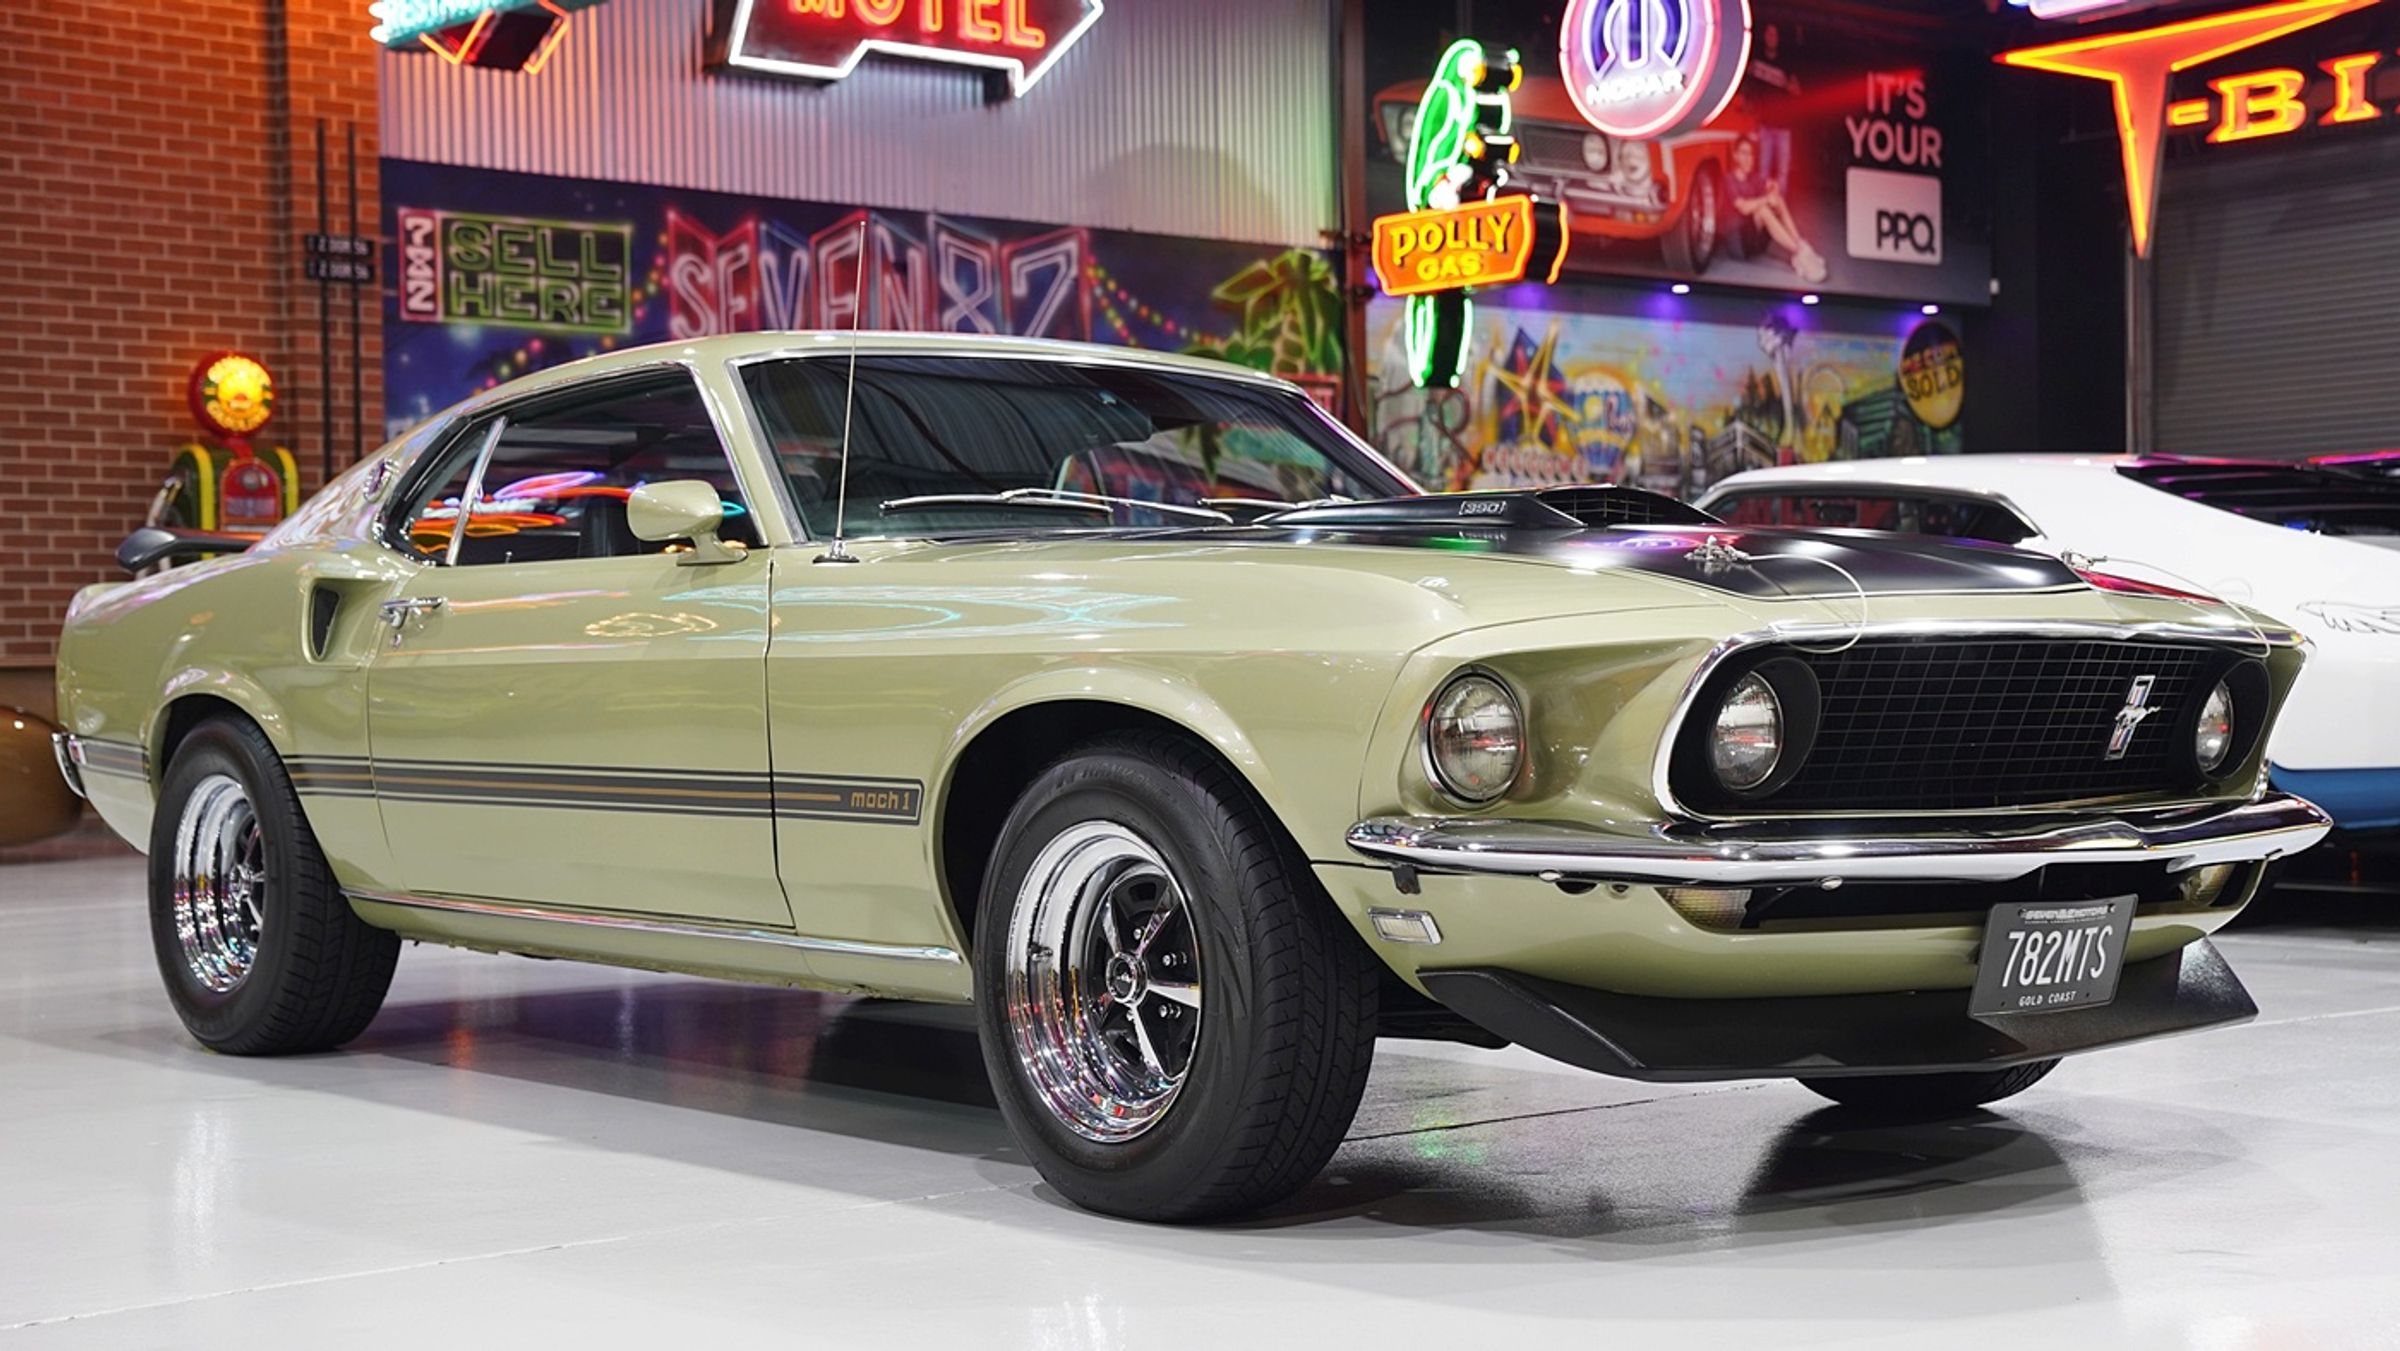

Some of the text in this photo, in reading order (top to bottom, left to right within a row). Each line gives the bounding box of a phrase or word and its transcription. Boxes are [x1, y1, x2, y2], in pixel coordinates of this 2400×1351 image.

[1585, 69, 1688, 105] MOPAR
[1866, 71, 1926, 119] IT'S
[1845, 115, 1942, 168] YOUR
[450, 220, 622, 281] SELL
[1389, 211, 1513, 266] POLLY
[1876, 209, 1936, 255] PPQ
[1416, 251, 1482, 281] GAS
[450, 271, 622, 327] HERE
[1906, 366, 1960, 401] SOLD
[2002, 925, 2113, 987] 782MTS
[2018, 991, 2077, 1007] GOLD COAST
